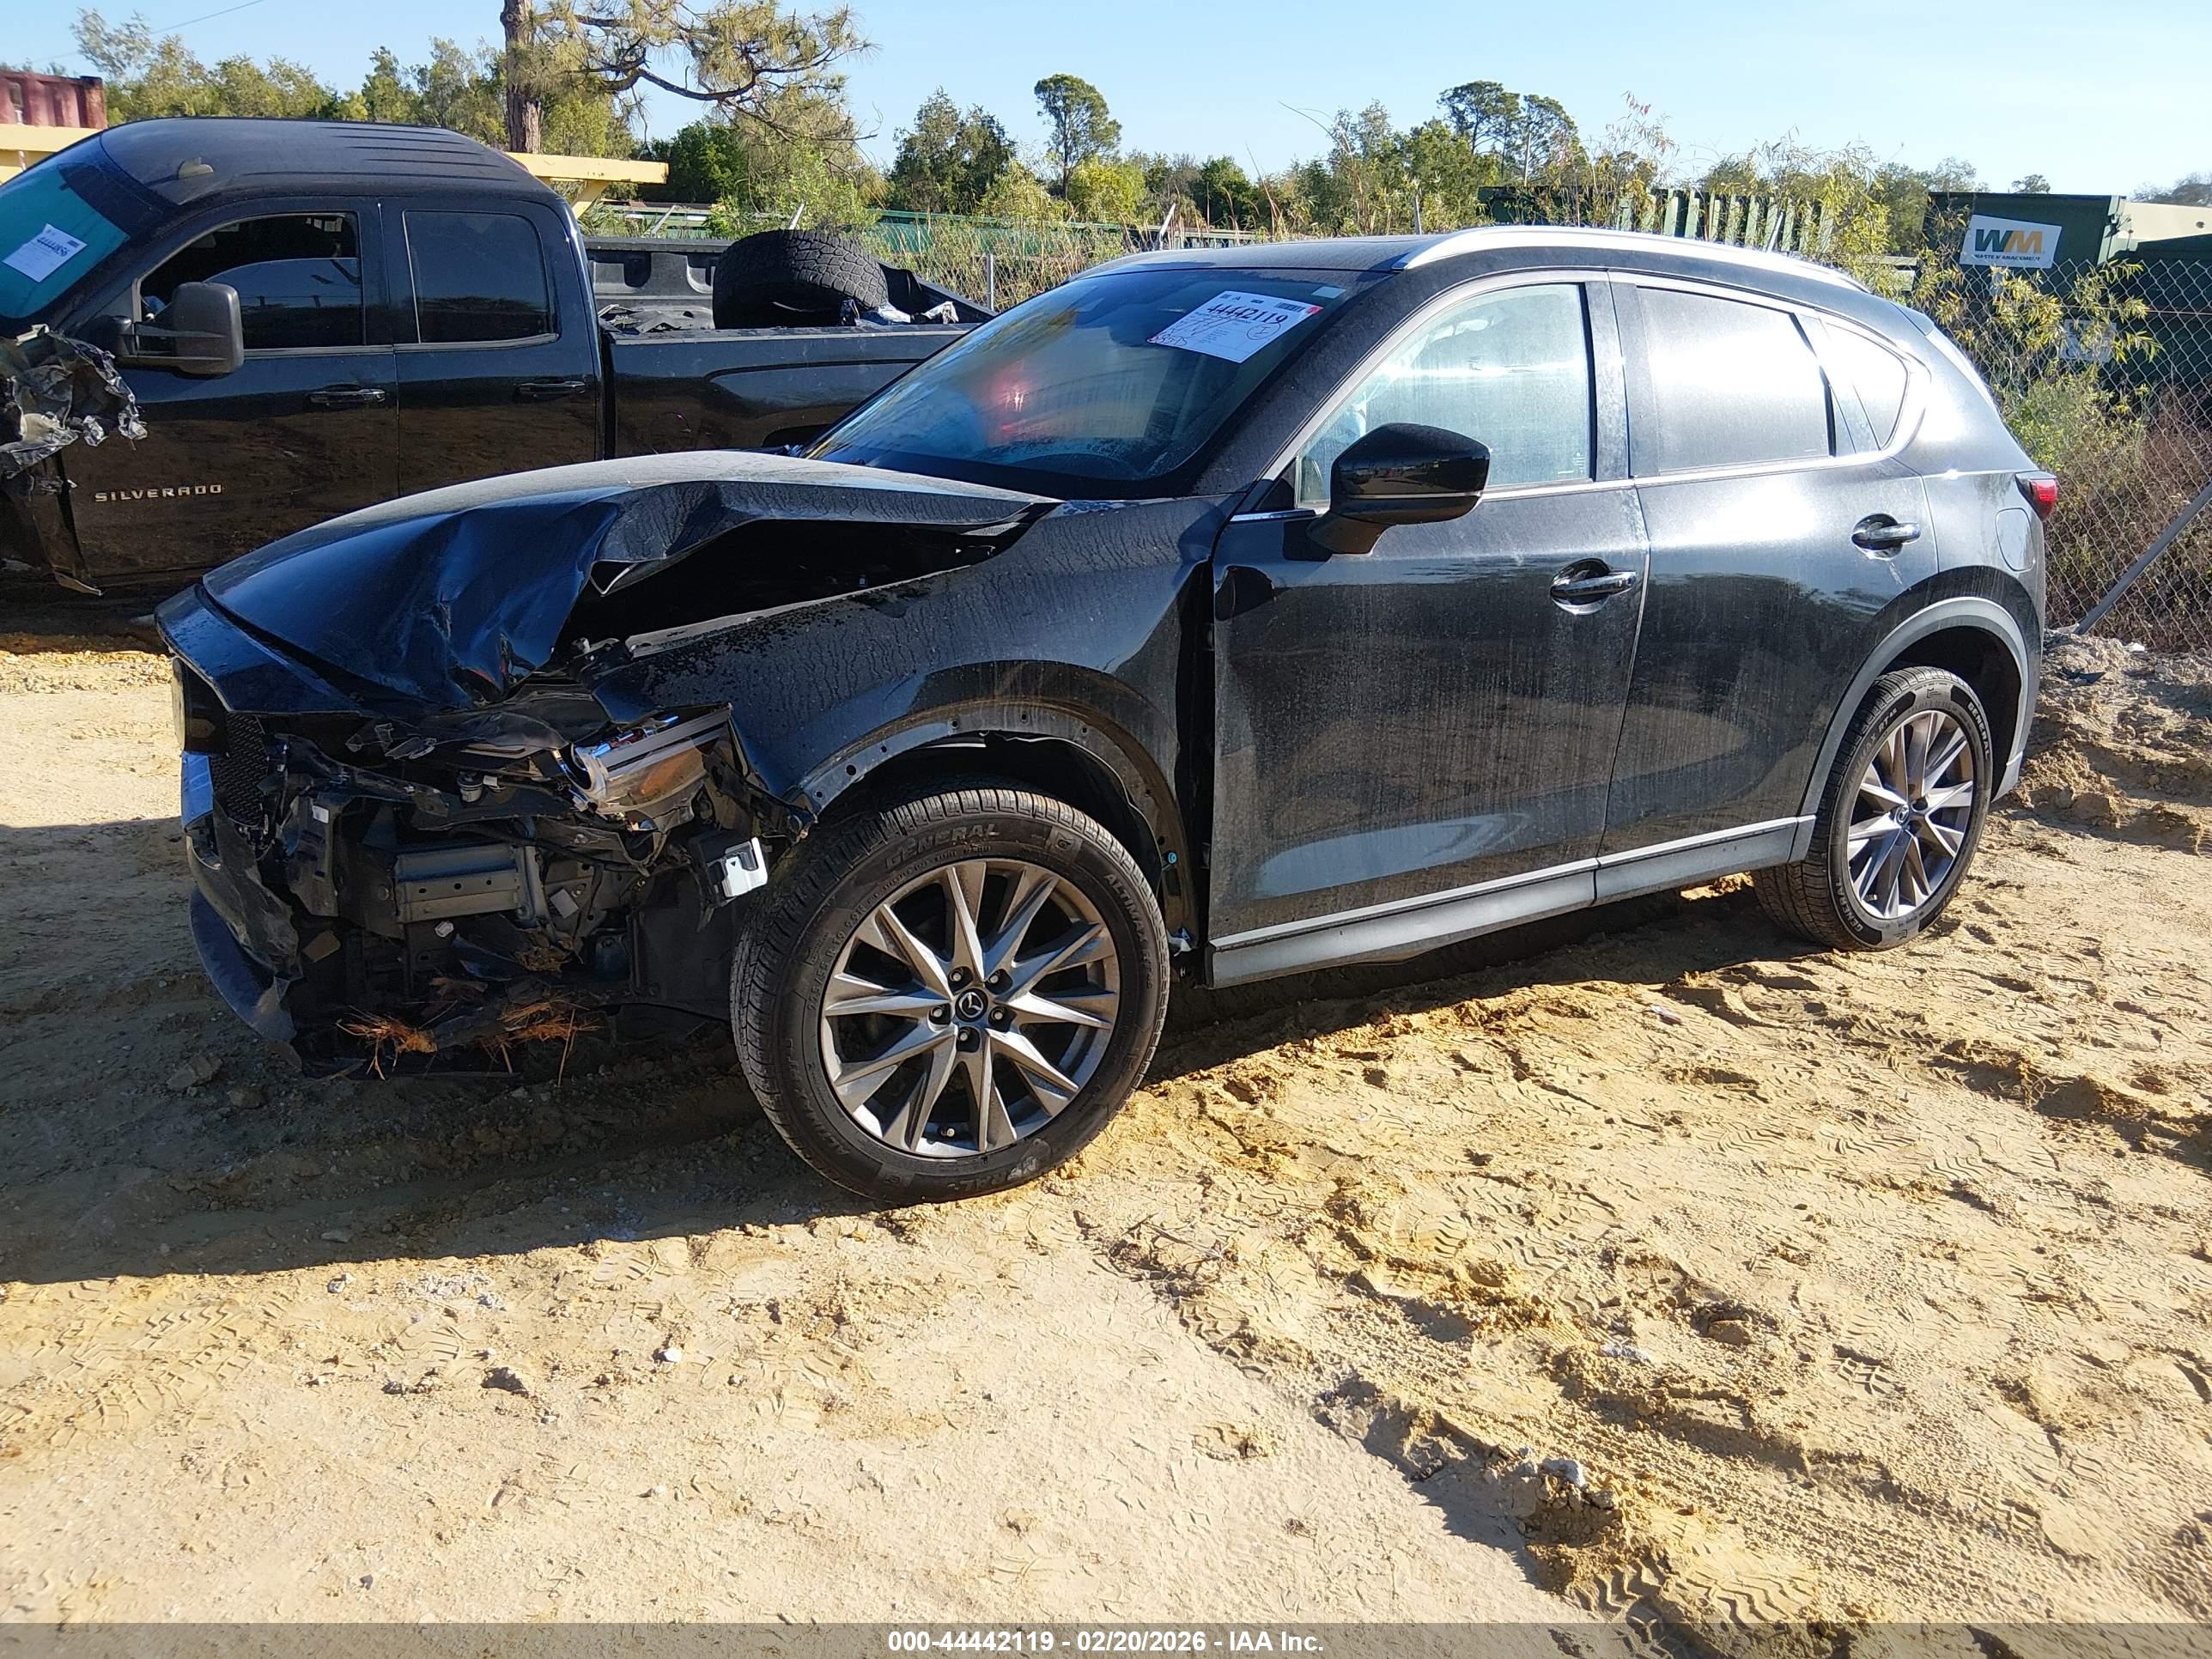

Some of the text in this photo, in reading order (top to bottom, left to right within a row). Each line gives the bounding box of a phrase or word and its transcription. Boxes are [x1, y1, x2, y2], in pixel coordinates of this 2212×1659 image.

[1974, 228, 2043, 254] WM
[1206, 302, 1288, 325] 44442119
[94, 484, 222, 502] SILVERADO
[1967, 702, 1990, 761] GENERAL
[884, 823, 1000, 869] GENERAL
[1103, 873, 1148, 945] ALTIMAX
[1836, 877, 1864, 932] GENERAL
